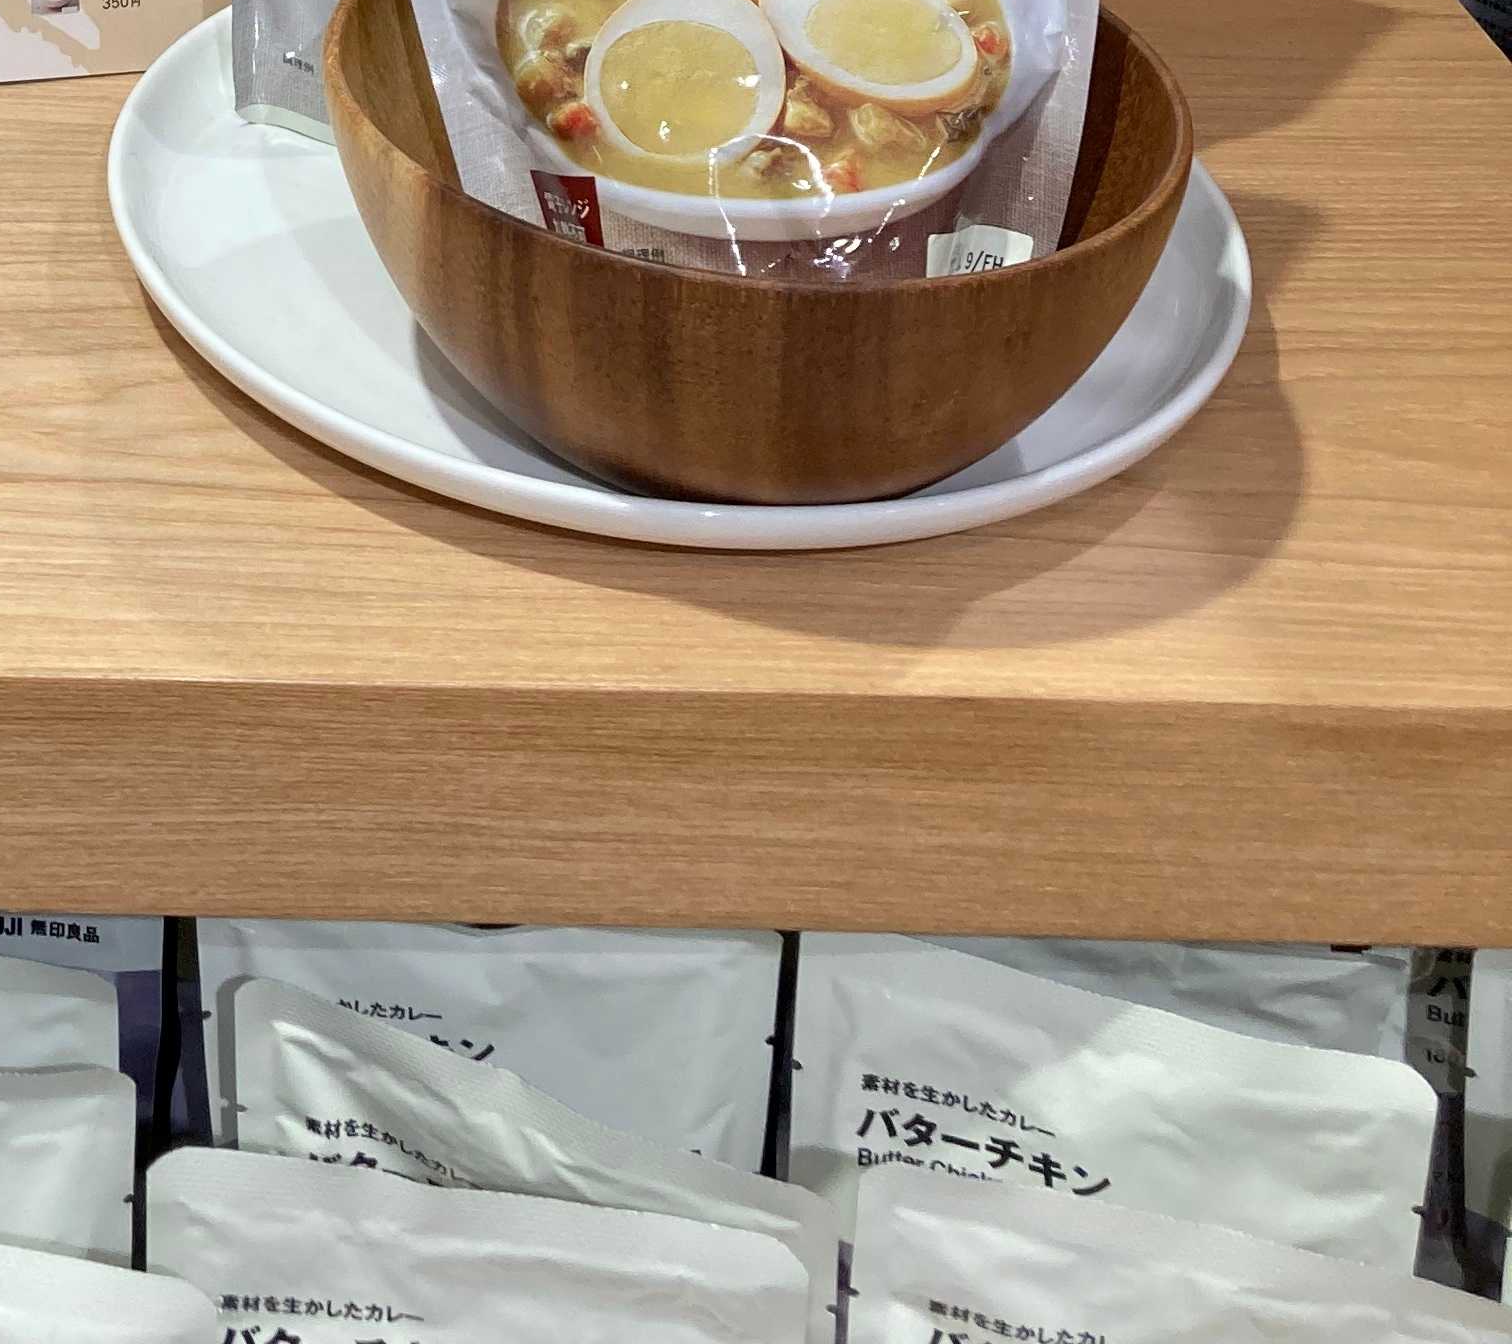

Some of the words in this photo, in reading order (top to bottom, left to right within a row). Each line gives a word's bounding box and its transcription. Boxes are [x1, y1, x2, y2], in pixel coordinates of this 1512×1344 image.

[30, 919, 101, 944] 無印良品
[861, 1073, 1056, 1138] 素材を生かしたカレー
[856, 1107, 1111, 1197] バターチキン
[221, 1294, 425, 1323] 素材を生かしたカレー
